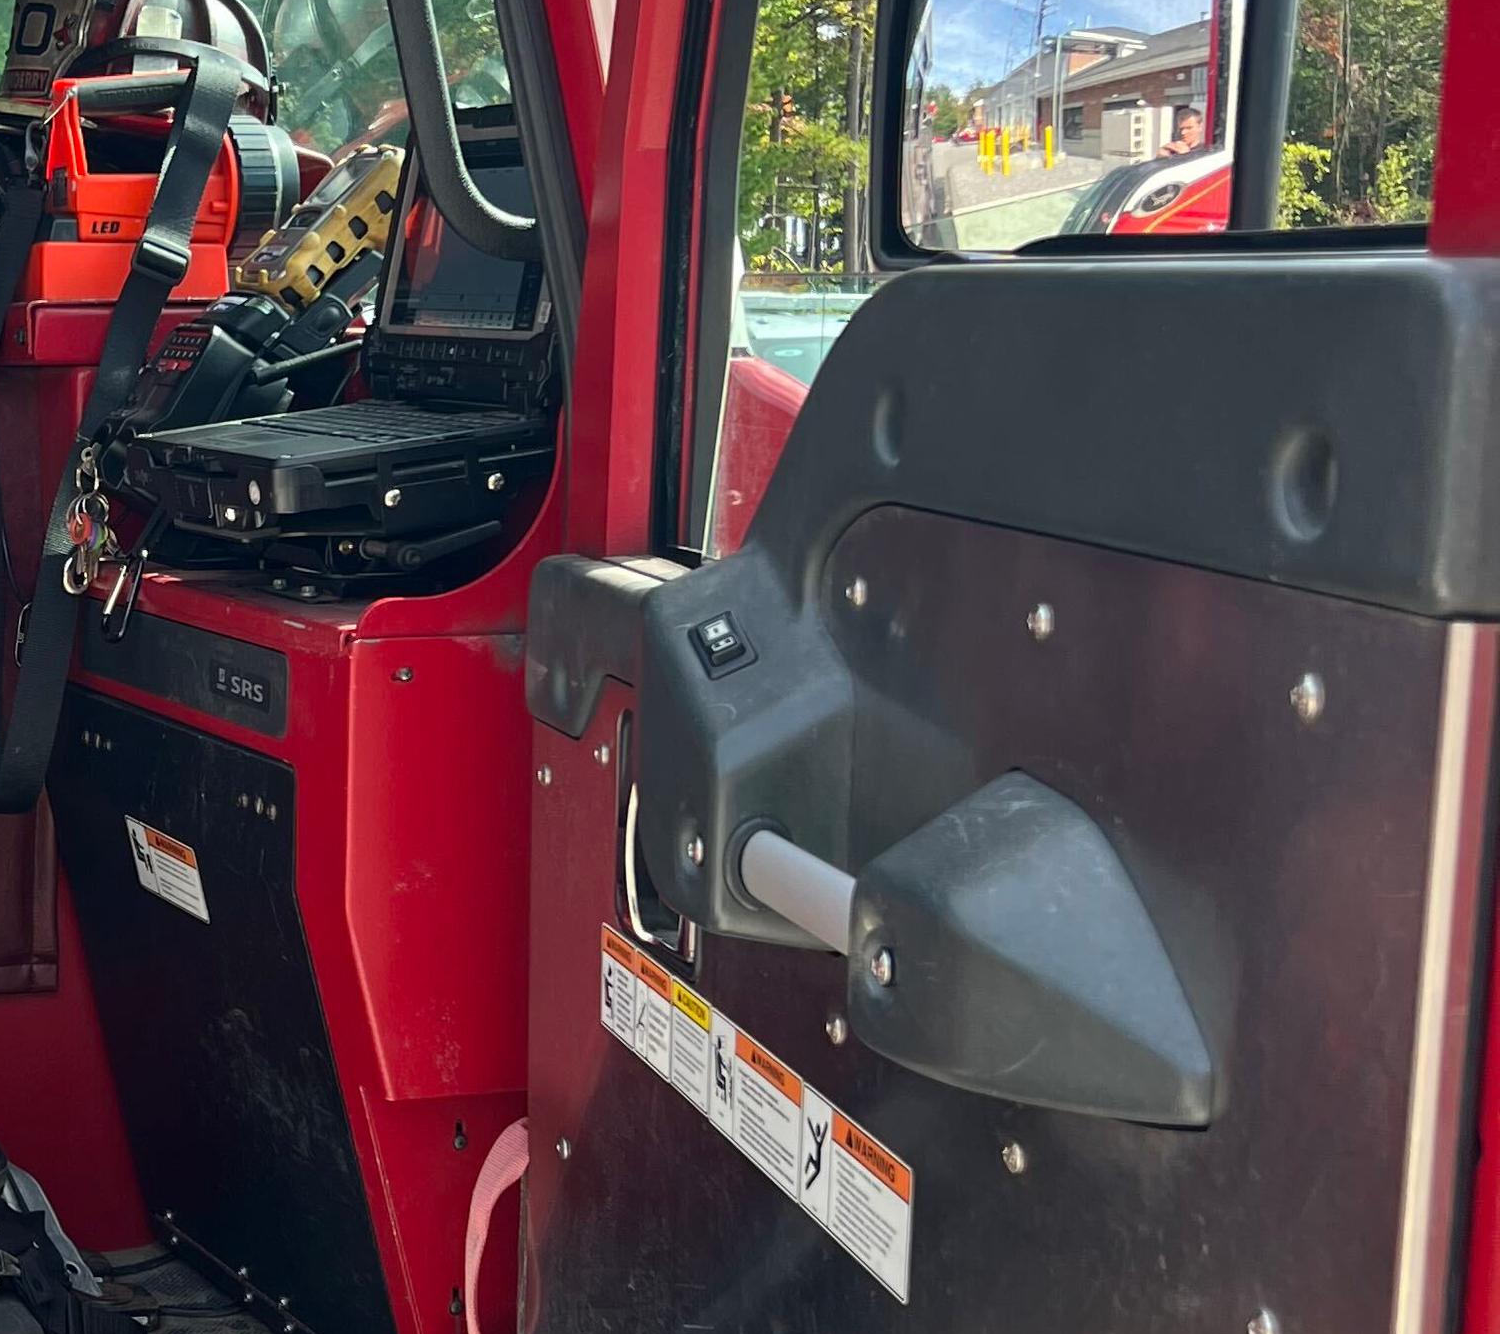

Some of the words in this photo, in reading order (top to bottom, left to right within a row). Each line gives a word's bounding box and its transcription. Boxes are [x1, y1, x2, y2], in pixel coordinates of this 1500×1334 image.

[91, 221, 121, 234] LED
[230, 675, 263, 703] SRS
[853, 1133, 896, 1183] WARNING
